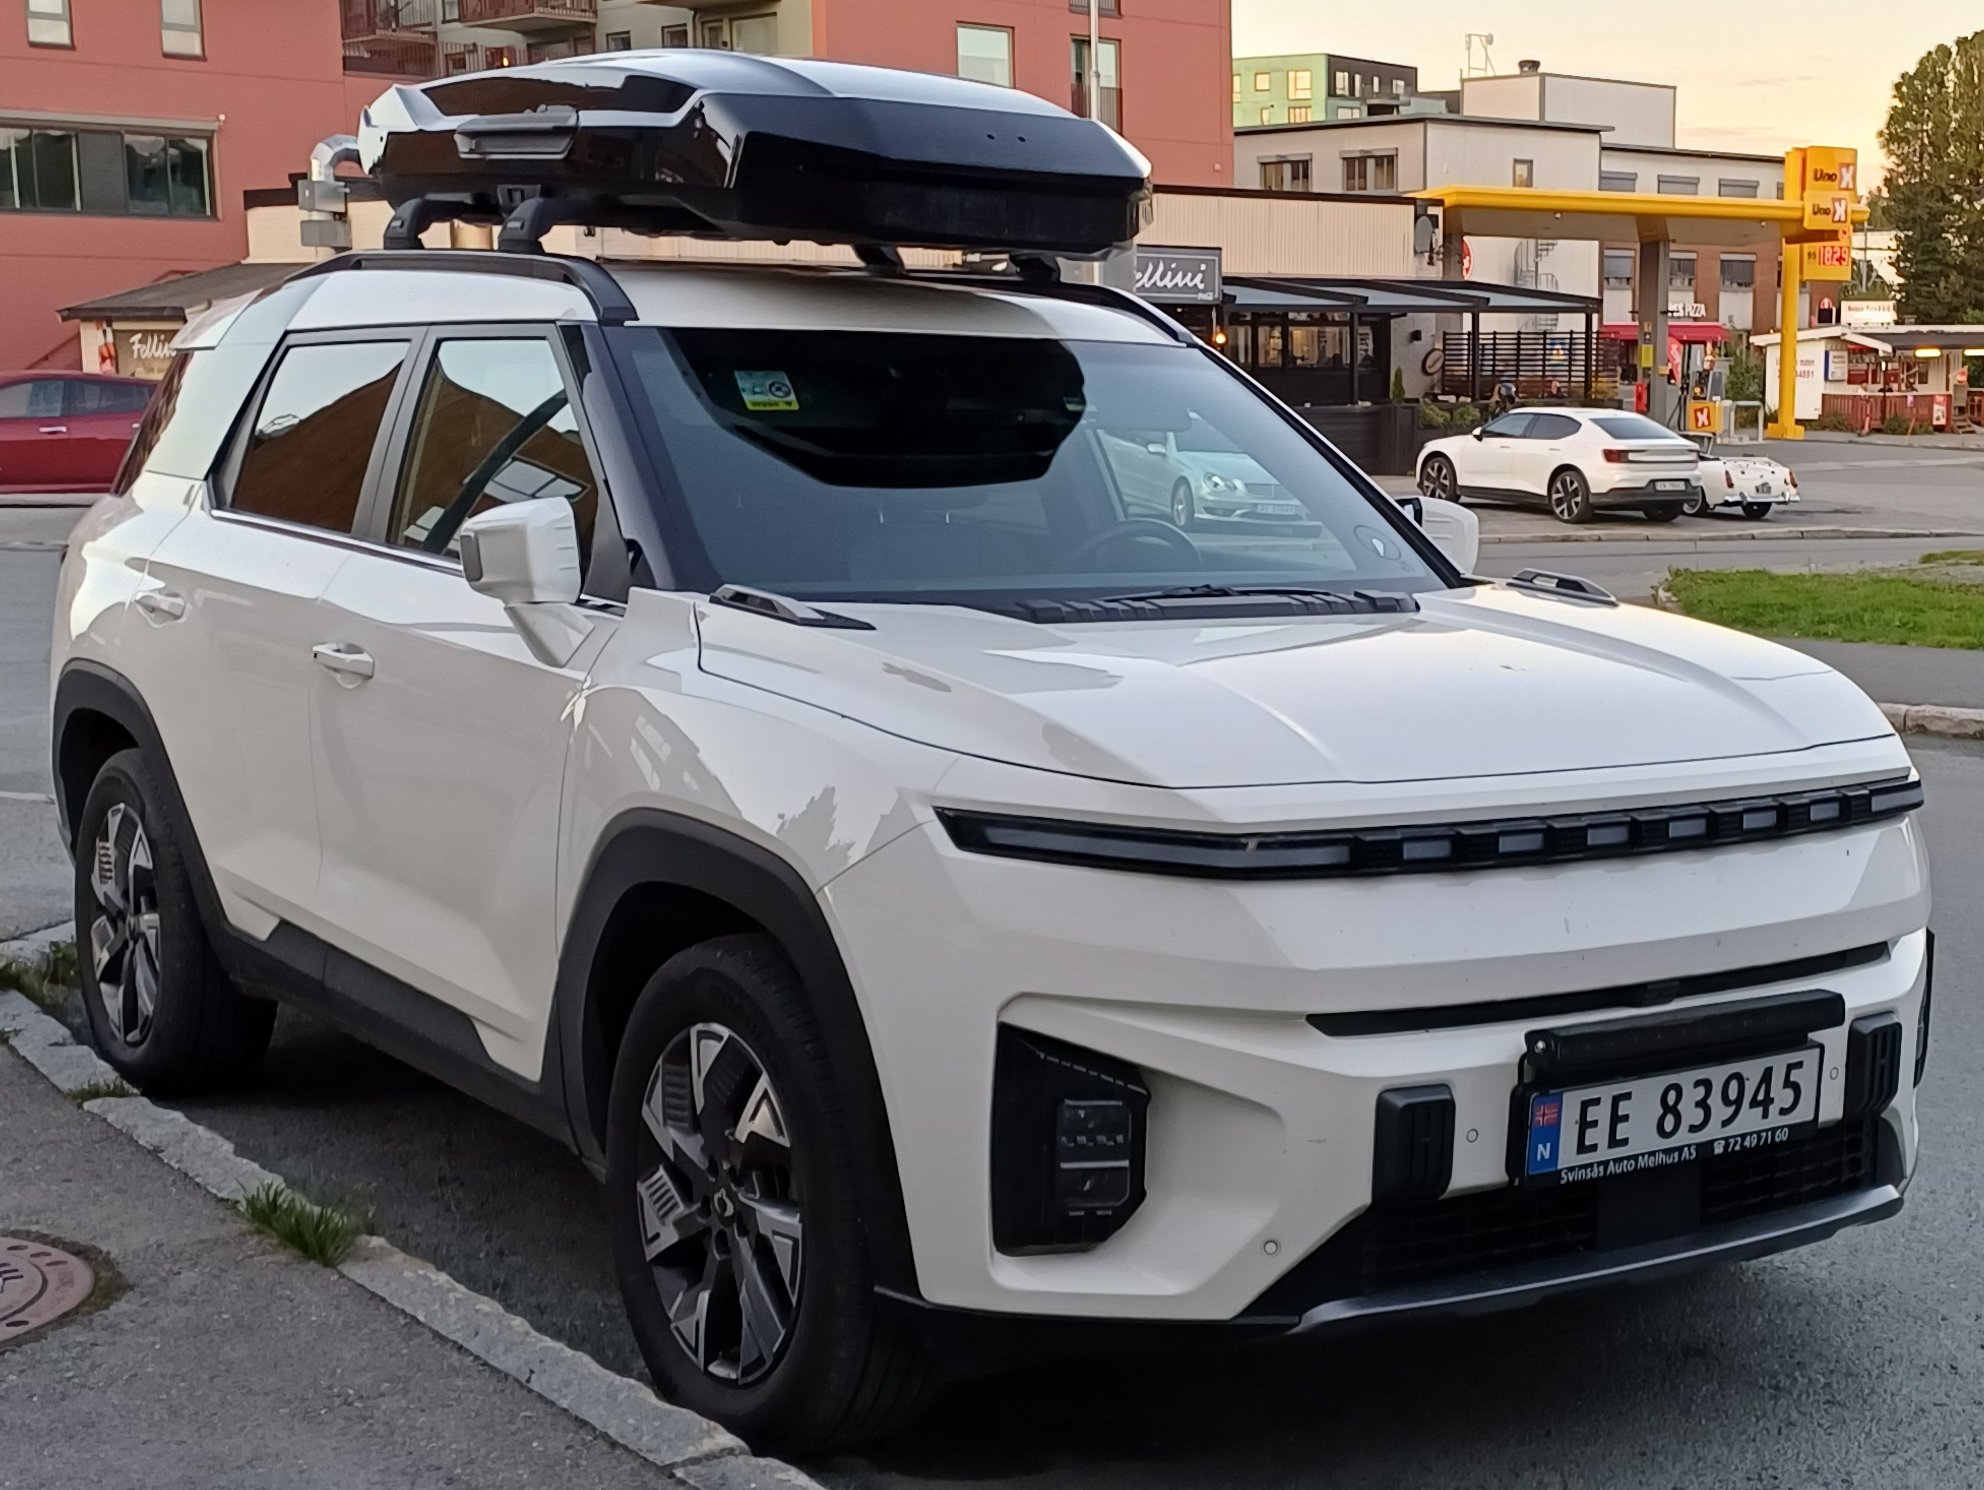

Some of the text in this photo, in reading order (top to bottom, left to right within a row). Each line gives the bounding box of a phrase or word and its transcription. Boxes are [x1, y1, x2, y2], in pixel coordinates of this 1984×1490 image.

[1813, 164, 1854, 190] Uno X
[1812, 199, 1846, 222] Uno X
[1685, 303, 1707, 318] PIZZA
[1576, 1060, 1804, 1155] EE 83945
[1536, 1143, 1551, 1162] N
[1560, 1127, 1789, 1185] Svinsås Auto Melhus AS 72 49 71 60
